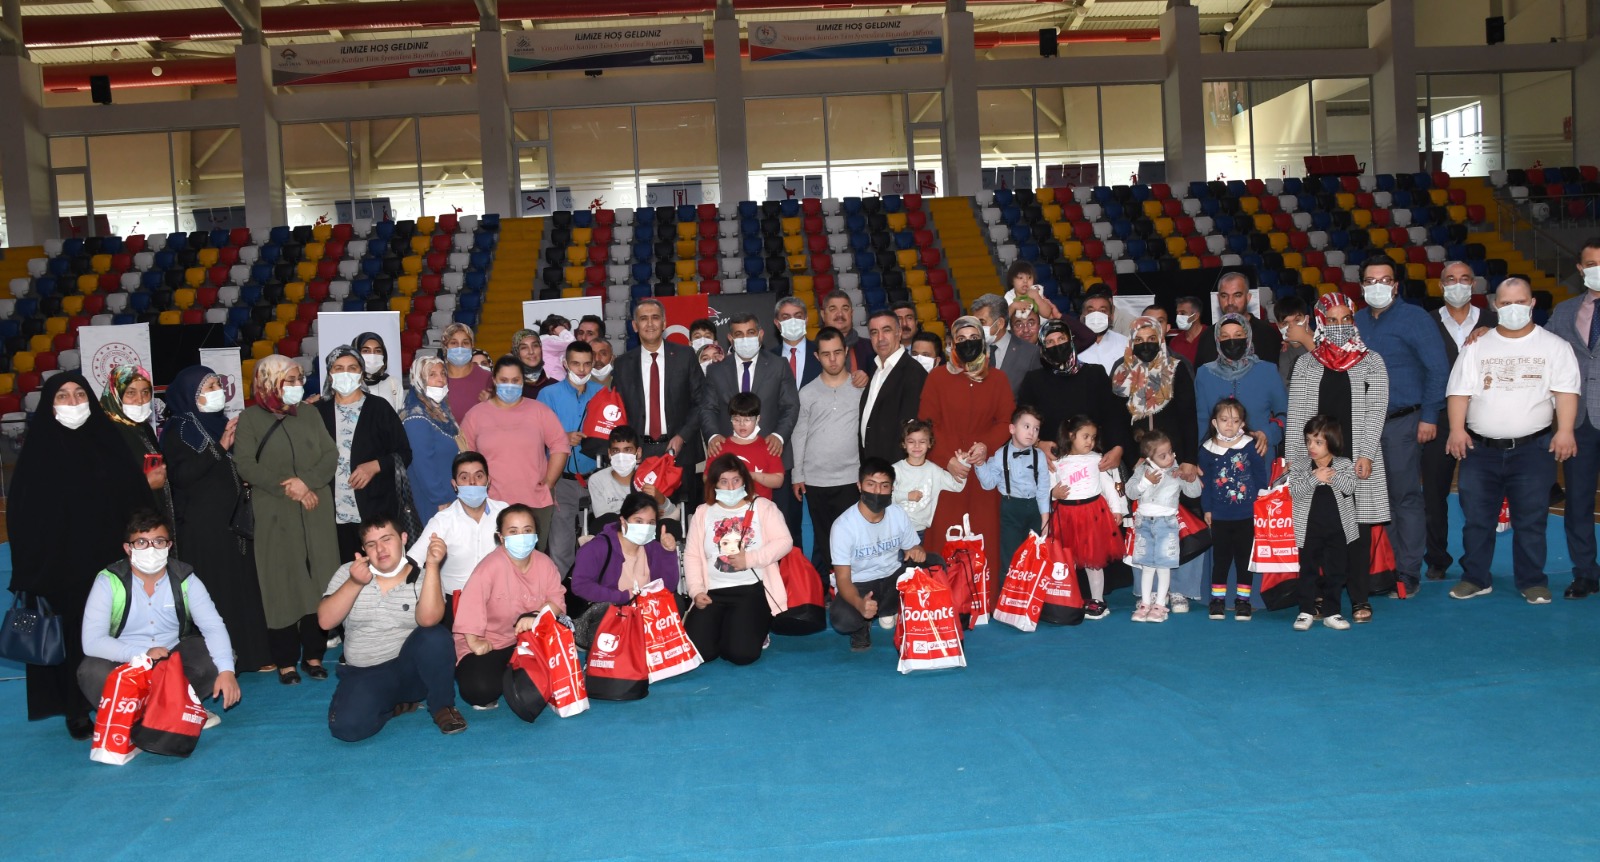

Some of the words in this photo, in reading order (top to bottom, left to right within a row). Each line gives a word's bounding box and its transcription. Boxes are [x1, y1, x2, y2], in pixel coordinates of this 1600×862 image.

[845, 21, 863, 32] HOŞ
[604, 31, 622, 42] HOŞ
[370, 43, 389, 54] HOŞ
[390, 41, 429, 52] GELDİNİZ
[1532, 357, 1546, 365] SEA
[1069, 466, 1089, 485] NIKE
